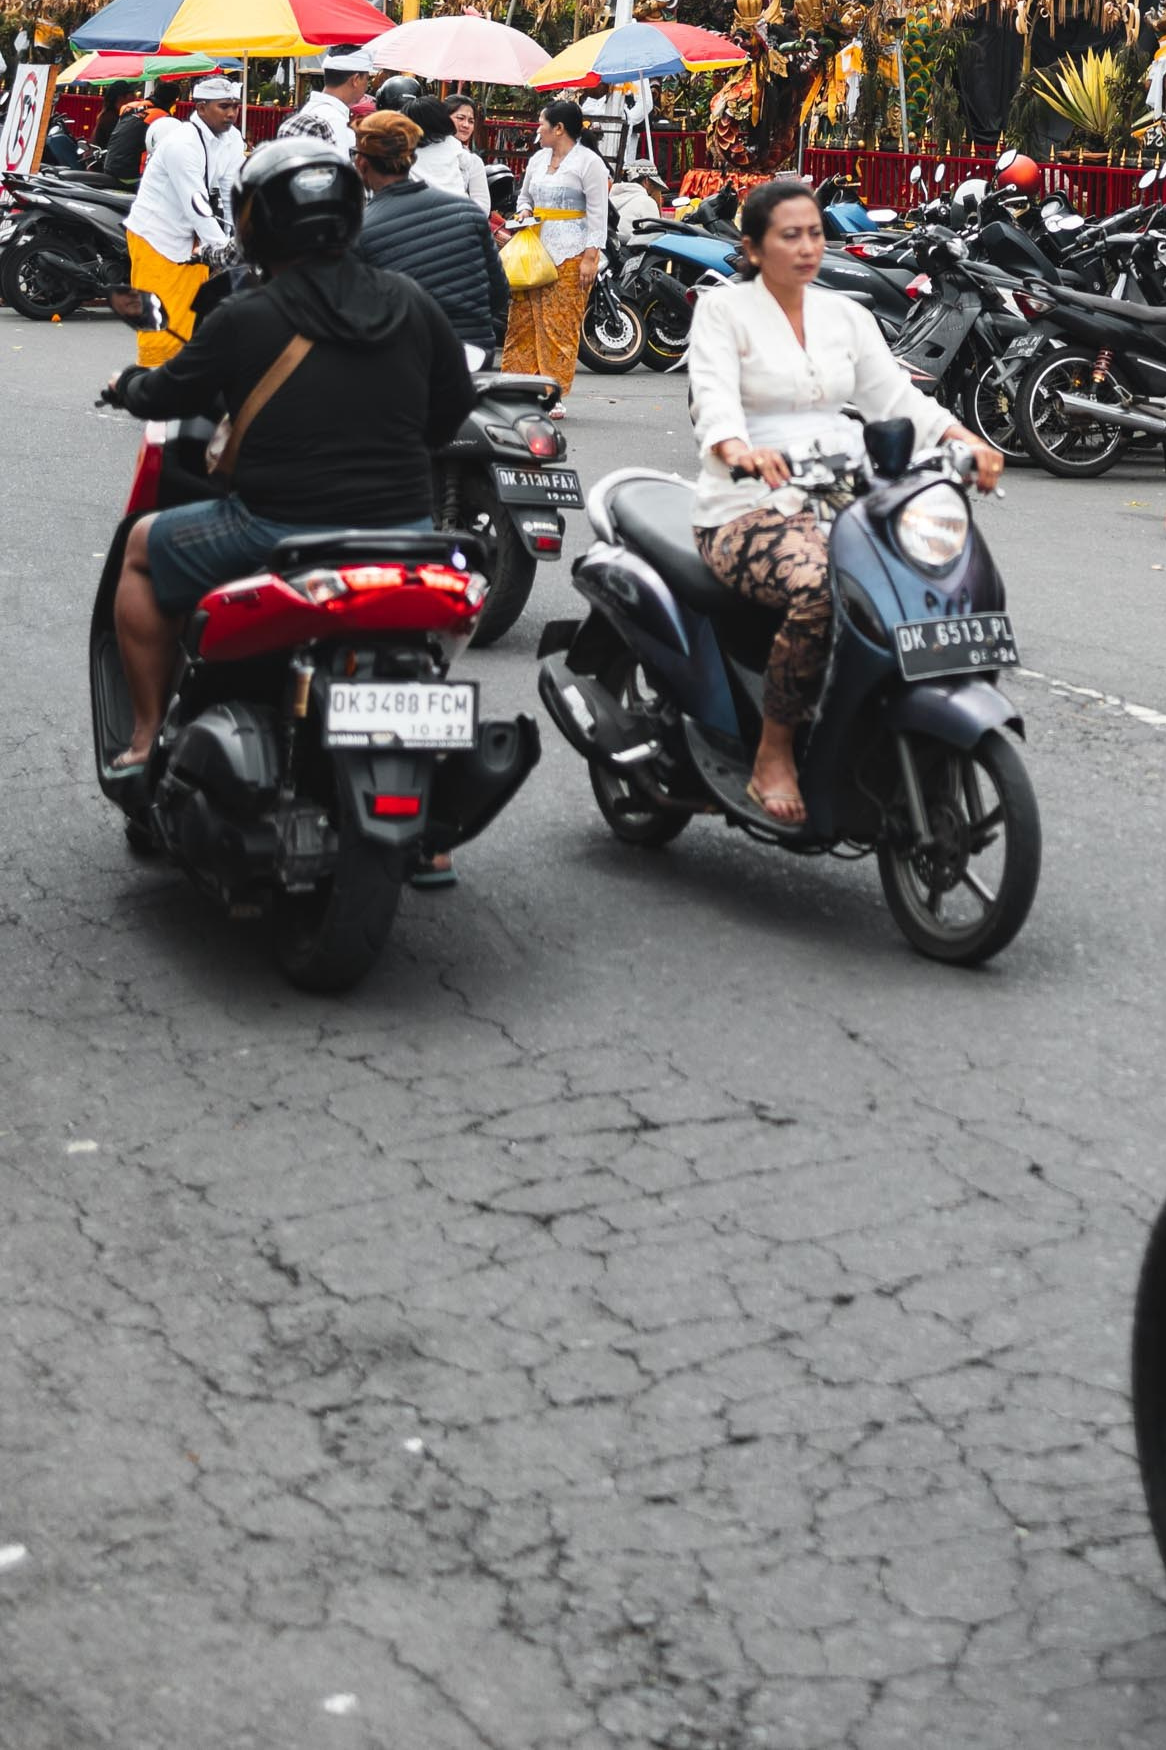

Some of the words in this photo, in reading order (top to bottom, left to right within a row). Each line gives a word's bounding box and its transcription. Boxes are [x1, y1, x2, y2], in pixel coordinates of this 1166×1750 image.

[499, 470, 518, 486] DK
[551, 474, 576, 489] FAX
[900, 625, 927, 653] DK
[935, 618, 985, 647] 6513
[989, 617, 1013, 641] PL
[332, 690, 361, 714] DK
[427, 692, 468, 715] FCM
